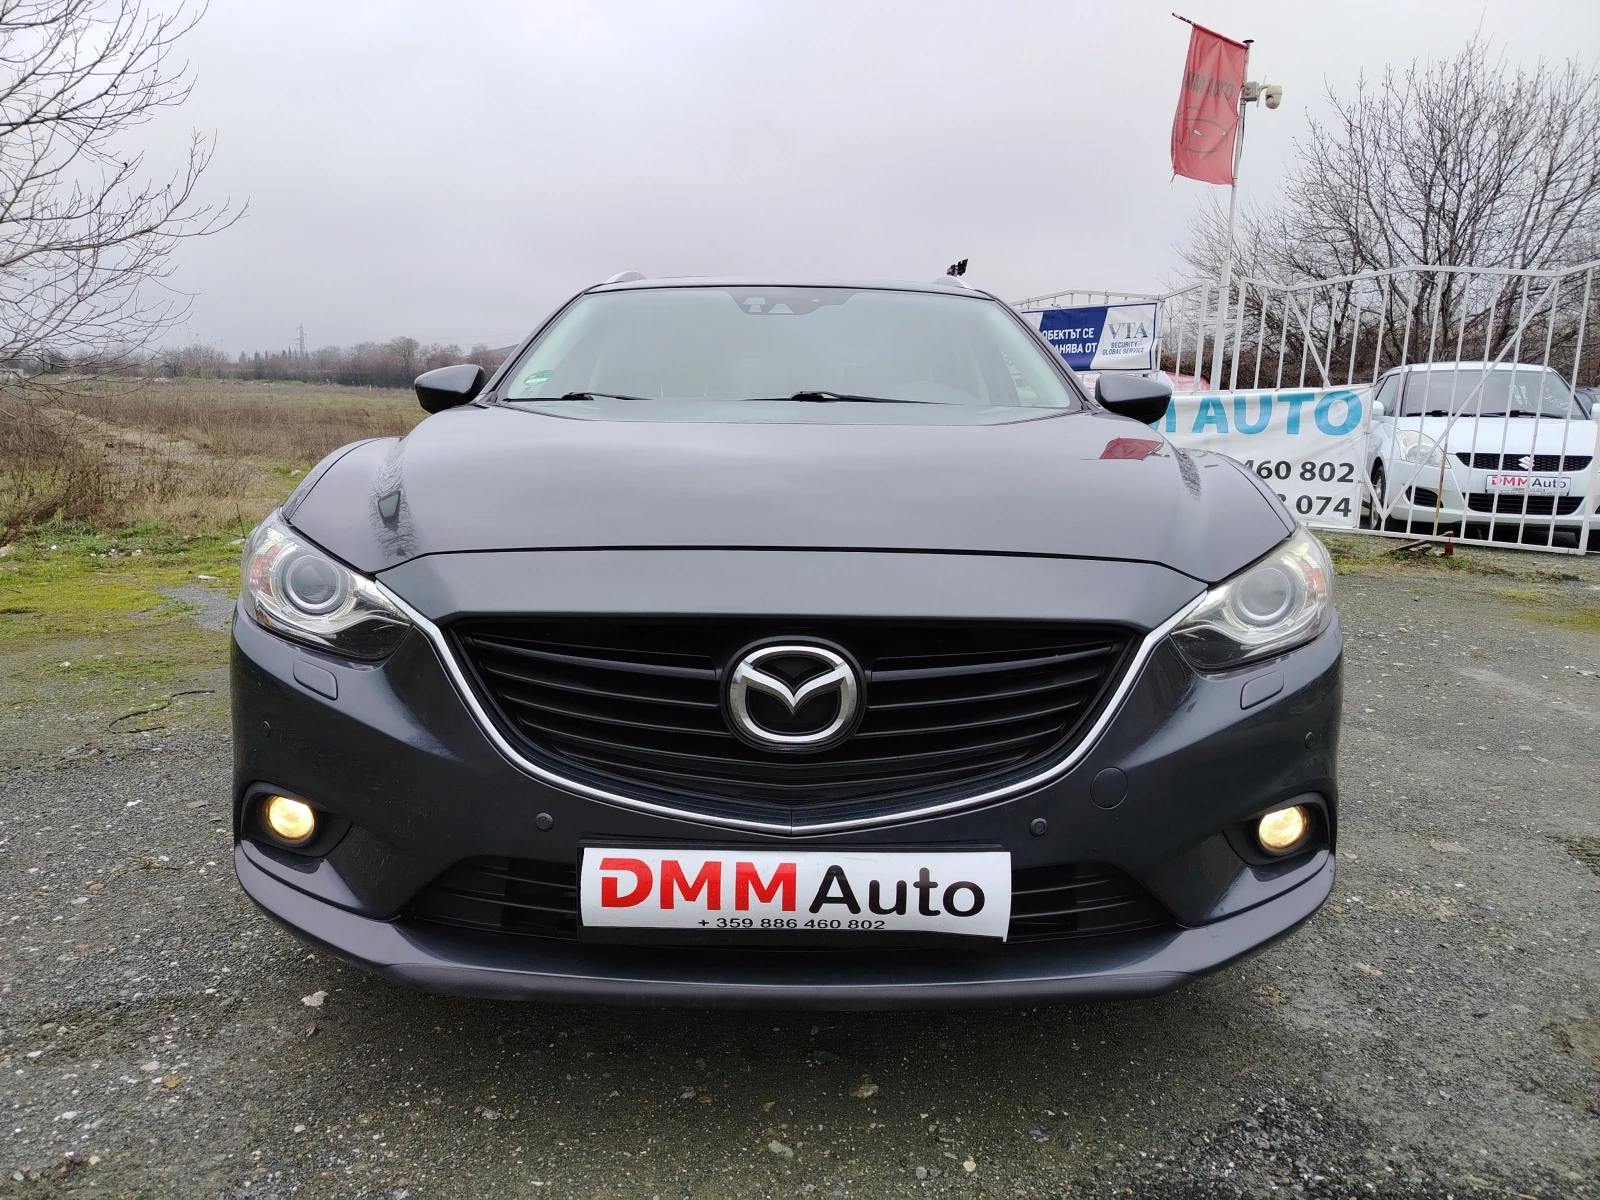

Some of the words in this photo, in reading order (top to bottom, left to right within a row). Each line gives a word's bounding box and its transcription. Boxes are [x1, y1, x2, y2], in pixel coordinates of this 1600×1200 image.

[1042, 328, 1081, 340] ОБЕКТЪТ
[1083, 328, 1095, 338] СЕ
[1107, 321, 1148, 339] VTA
[1085, 342, 1098, 353] ОТ
[1102, 348, 1121, 356] GLOBAL
[1191, 390, 1363, 436] AUTO
[1299, 461, 1355, 483] 802
[1295, 495, 1352, 517] 074
[716, 918, 753, 928] 359
[760, 918, 797, 928] 886
[804, 919, 841, 929] 460
[847, 919, 886, 930] 802
